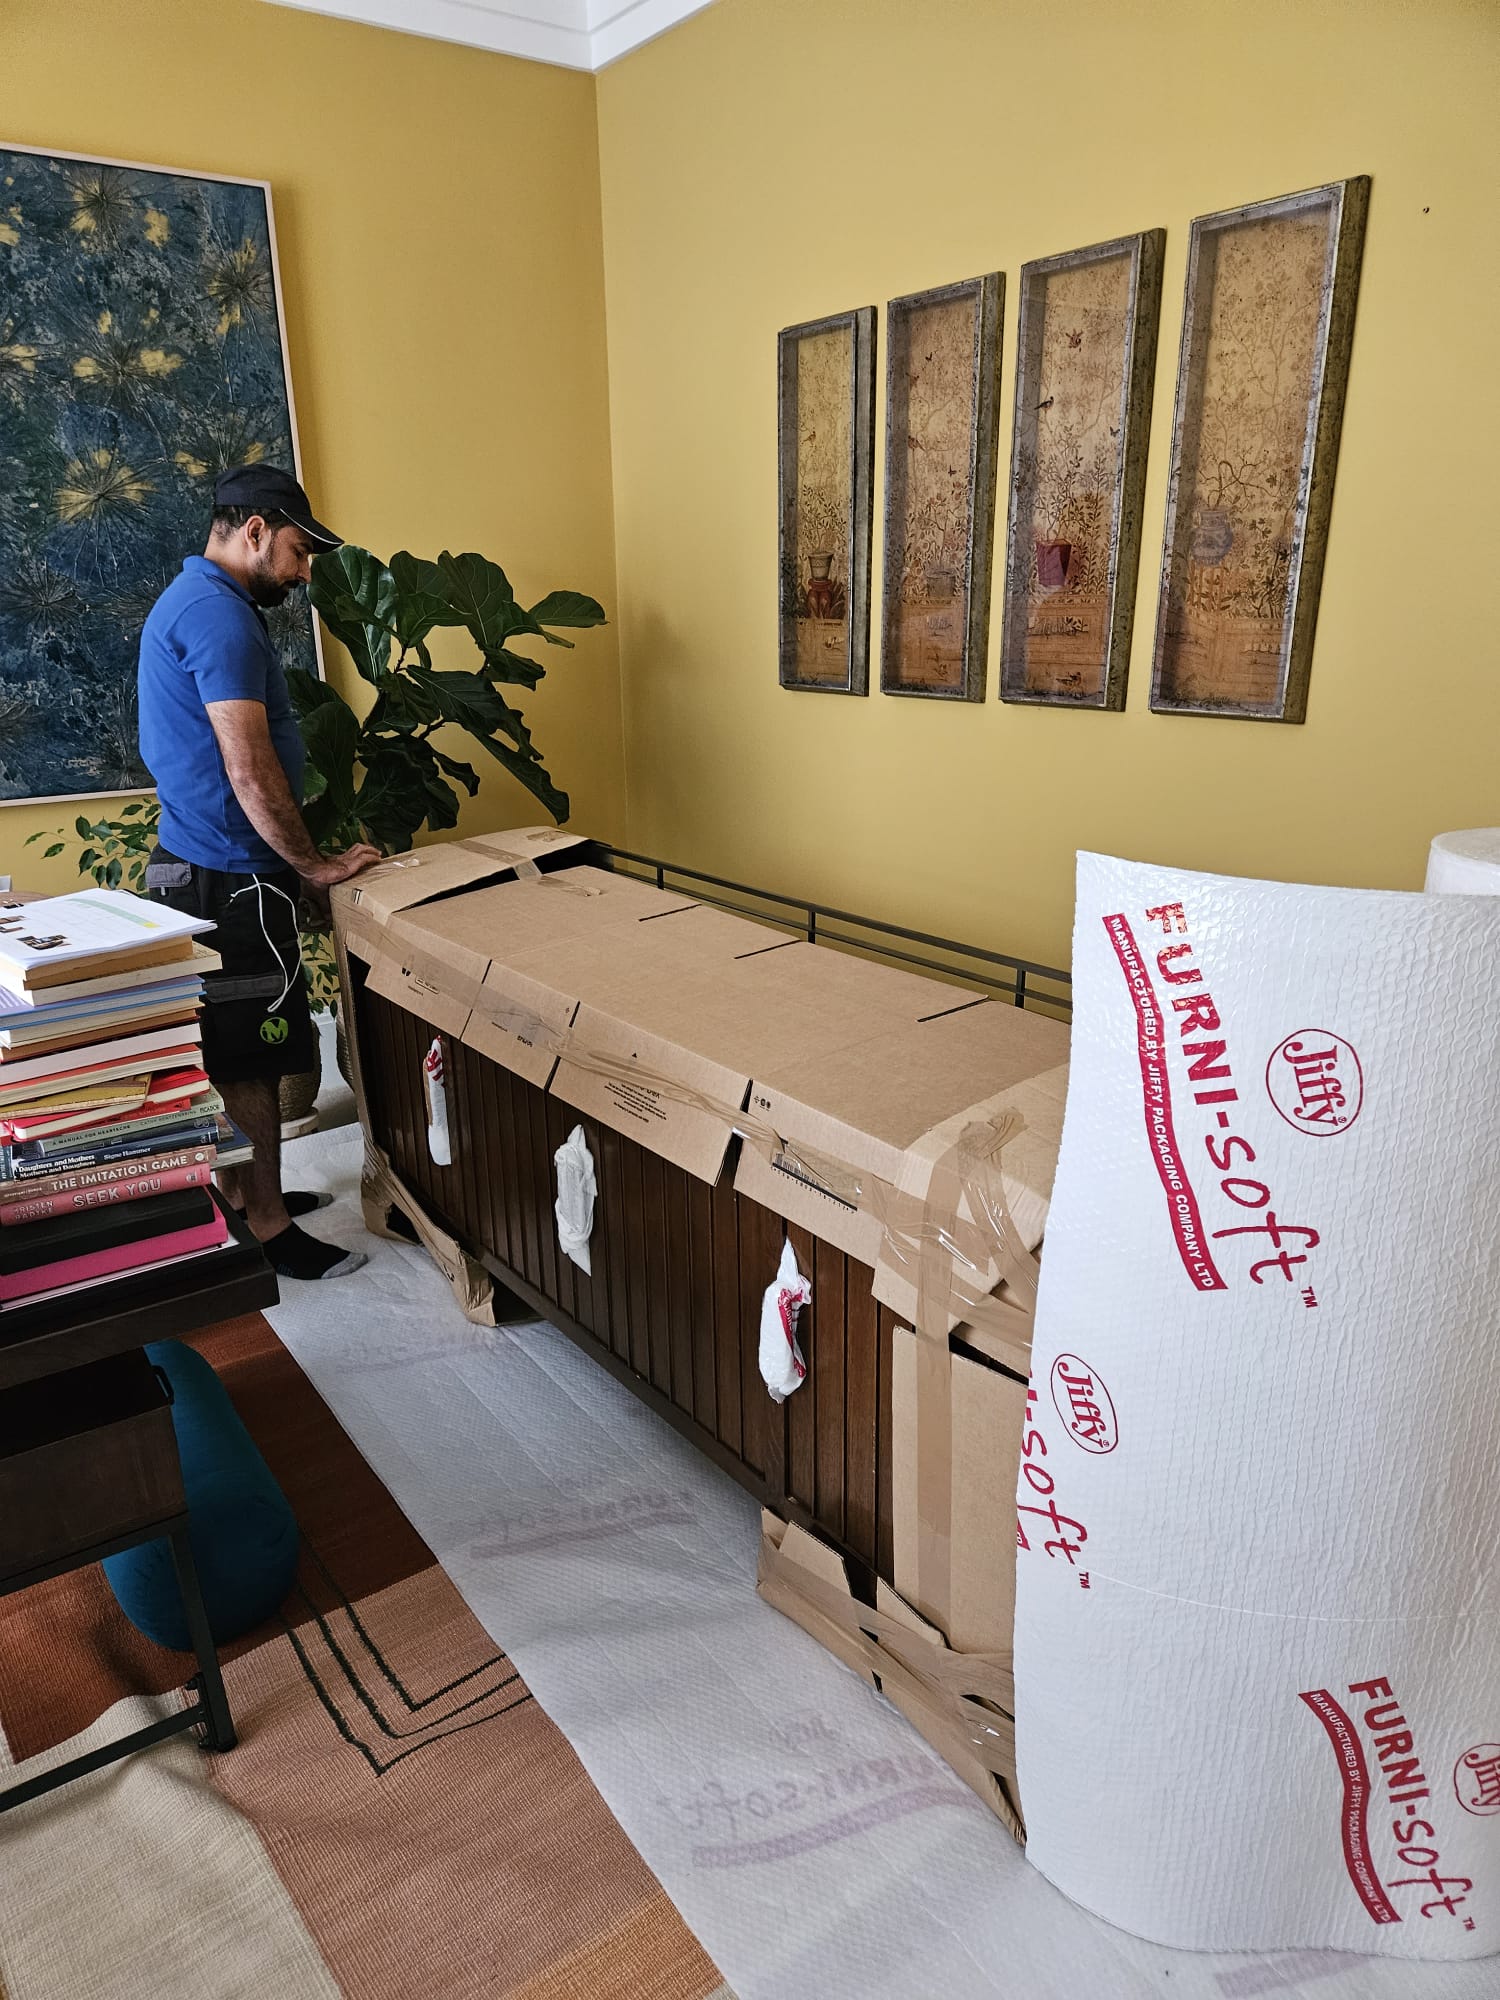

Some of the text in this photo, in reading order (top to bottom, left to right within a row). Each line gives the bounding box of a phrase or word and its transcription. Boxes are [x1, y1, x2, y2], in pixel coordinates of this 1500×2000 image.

[1110, 917, 1216, 1288] MANUFACTURED BY JIFFY PACKAGING COMPANY LTD
[58, 1135, 83, 1145] MANUAL
[103, 1146, 151, 1161] Signe Hammer
[19, 1154, 96, 1173] Daughters and Mothers
[20, 1160, 96, 1179] Mothers and Daughters
[51, 1155, 188, 1192] THE IMITATION GAME
[73, 1177, 162, 1208] SEEK YOU
[1310, 1693, 1392, 1922] MANUFACTURED BY JIFFY PACKAGING COMPANY LTD
[1348, 1676, 1473, 1919] FURNI-soft
